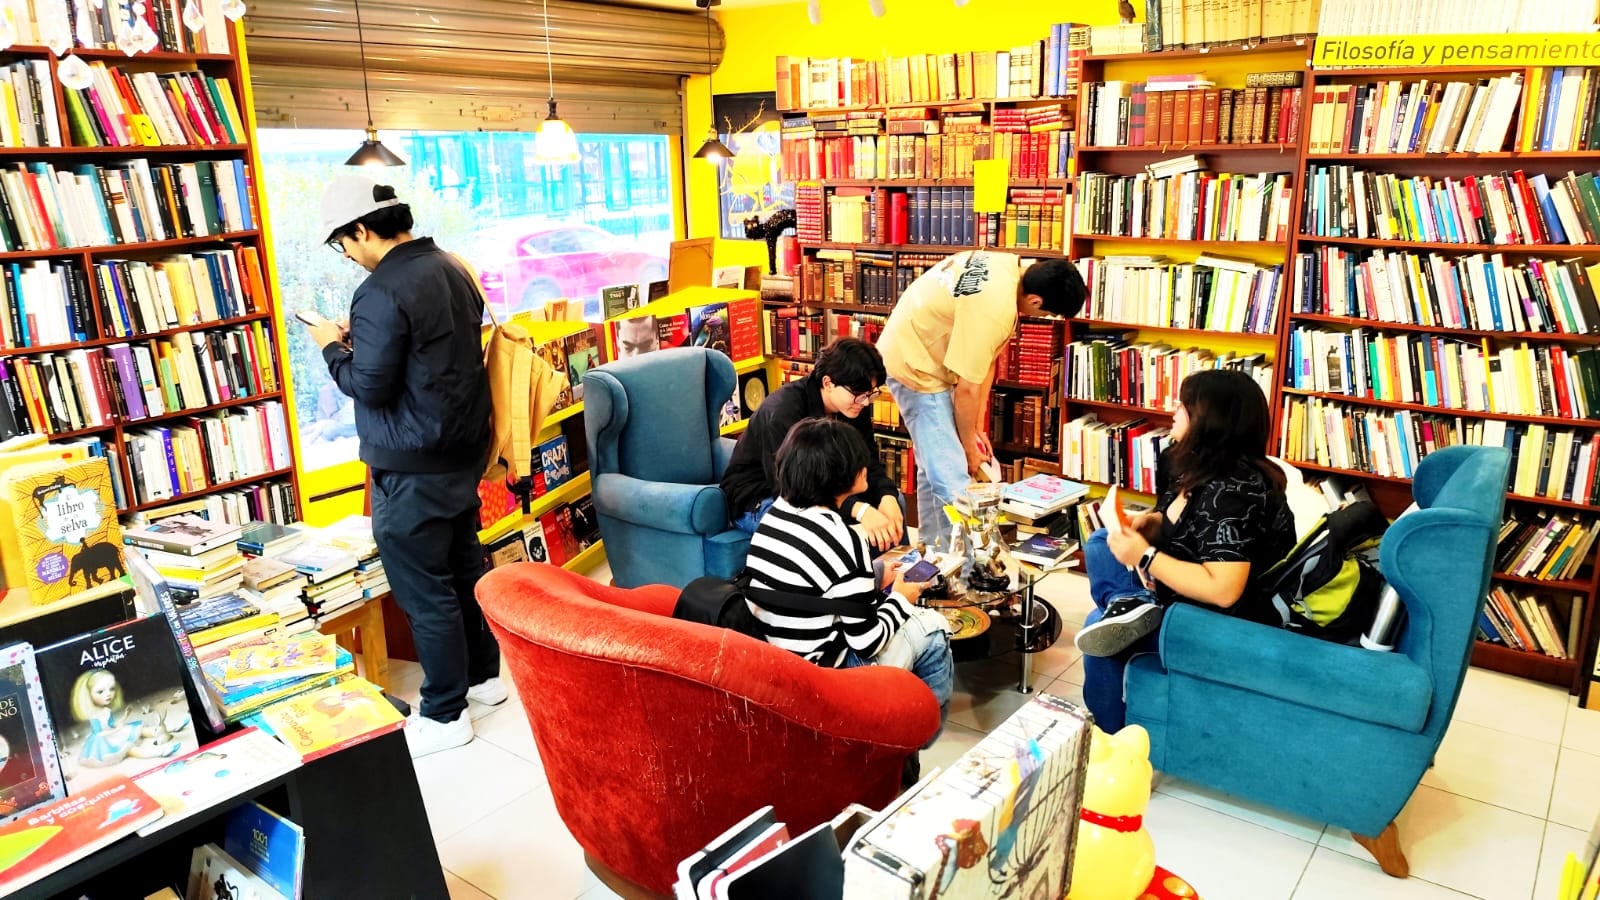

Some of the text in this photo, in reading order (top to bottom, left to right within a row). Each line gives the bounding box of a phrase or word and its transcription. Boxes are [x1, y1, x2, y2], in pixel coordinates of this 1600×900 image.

[1322, 39, 1600, 64] Filosofía y pensamiento
[541, 442, 567, 470] CRAZY
[57, 501, 85, 517] libro
[60, 519, 88, 535] selva
[80, 634, 136, 666] ALICE
[252, 828, 268, 846] 1001
